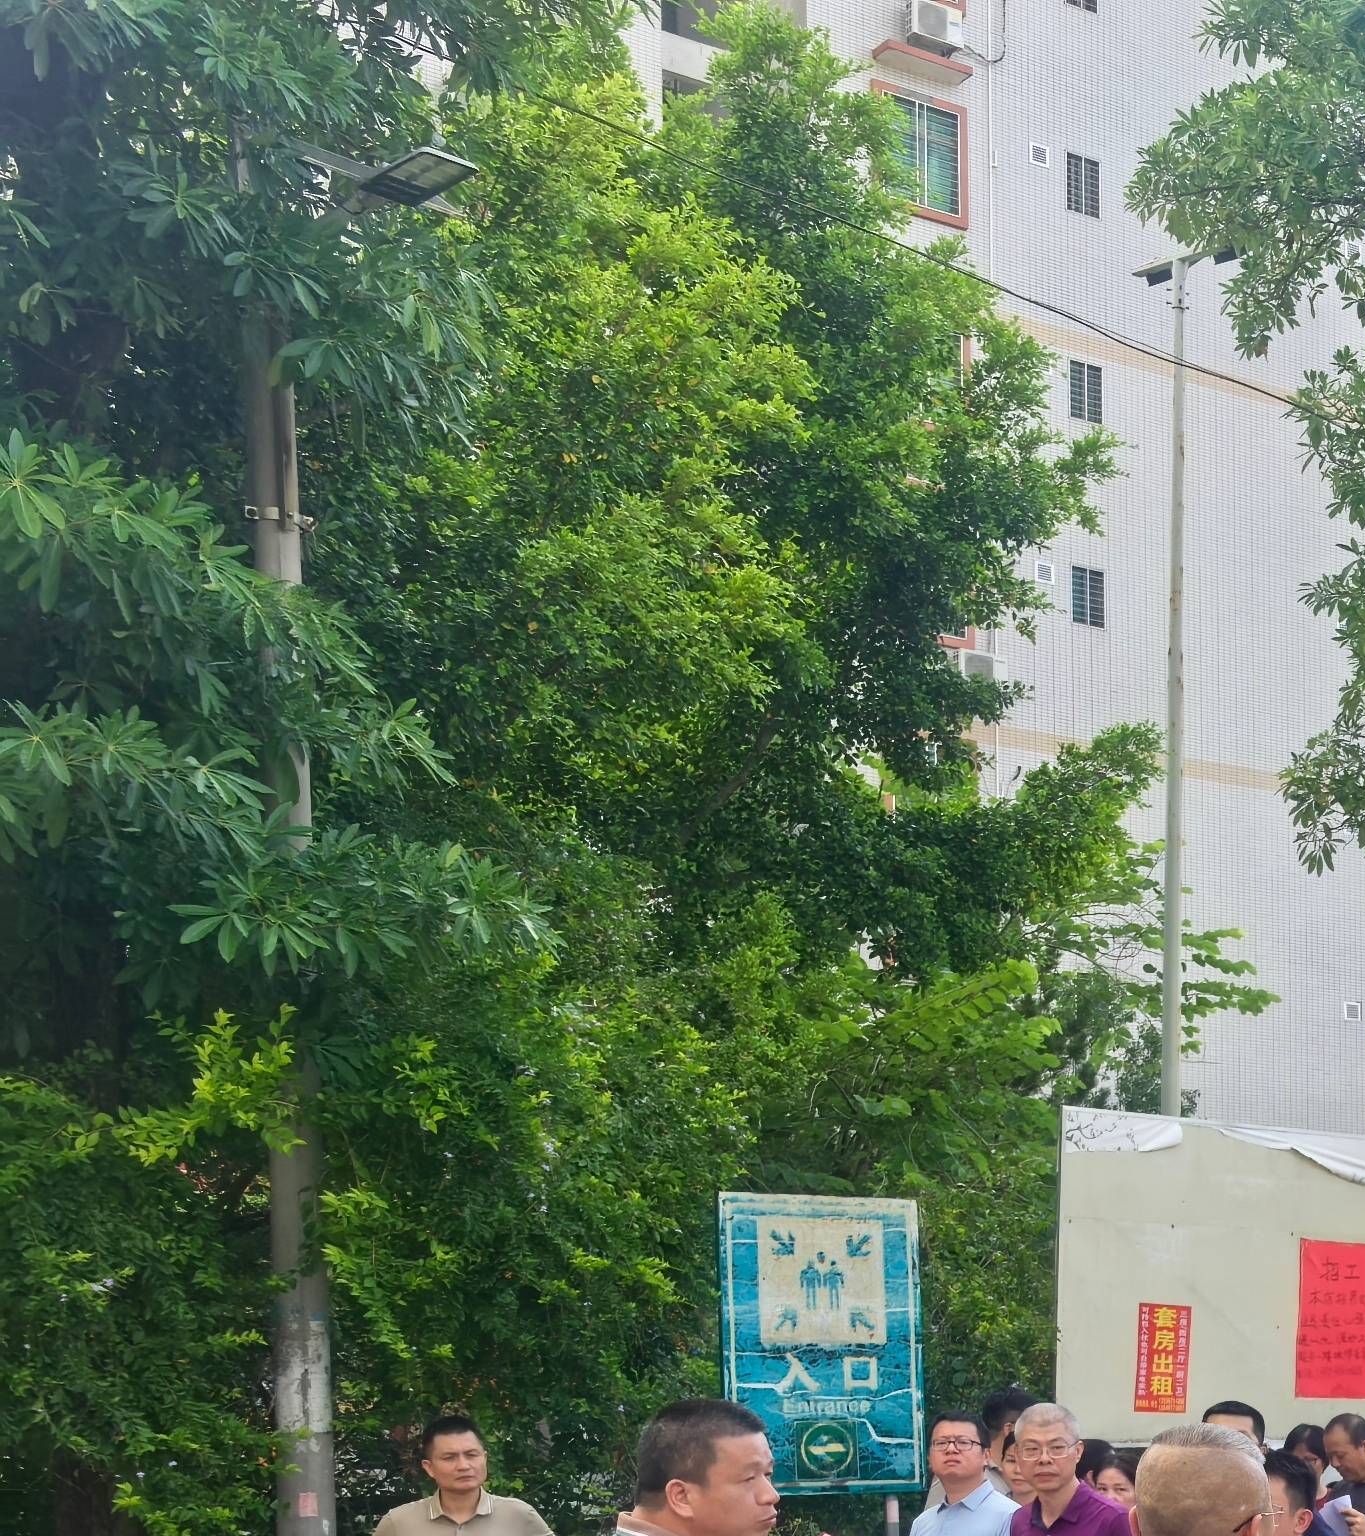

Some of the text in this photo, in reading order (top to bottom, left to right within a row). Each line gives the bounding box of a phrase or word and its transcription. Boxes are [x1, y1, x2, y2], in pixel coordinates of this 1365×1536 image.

[1319, 1256, 1361, 1281] 招工
[1150, 1306, 1177, 1396] 套房出租
[778, 1352, 878, 1392] 入口
[783, 1399, 872, 1416] Entrance
